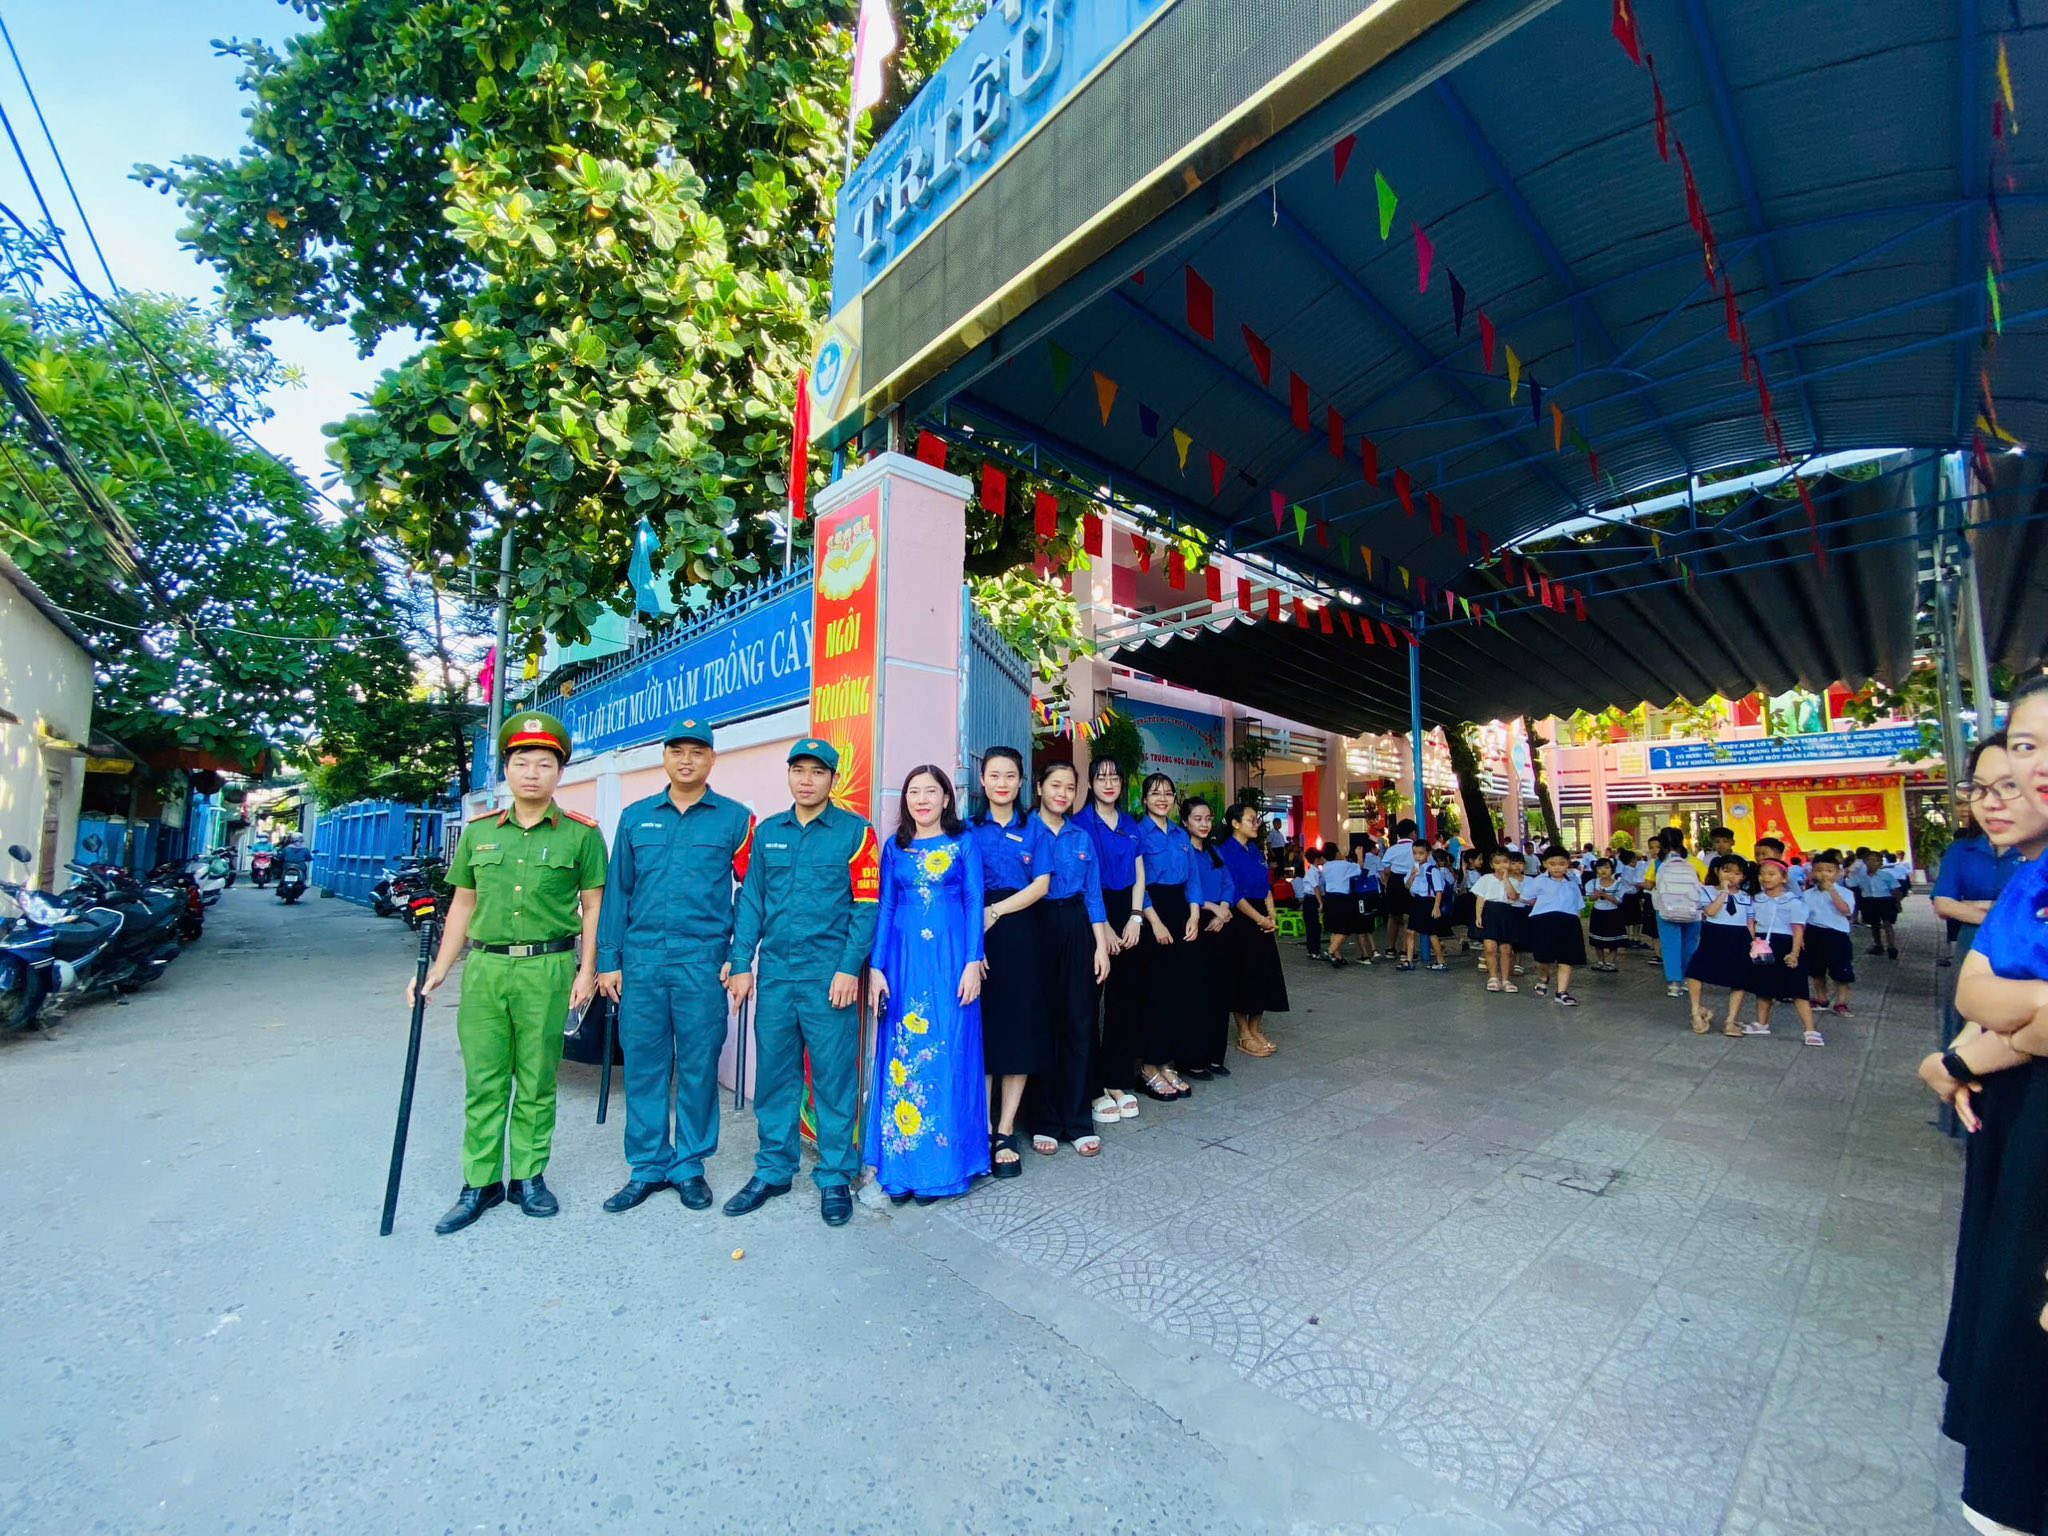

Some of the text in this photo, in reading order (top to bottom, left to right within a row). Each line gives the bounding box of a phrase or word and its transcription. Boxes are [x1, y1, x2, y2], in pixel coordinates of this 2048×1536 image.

[852, 0, 1064, 265] TRIỆU
[587, 702, 606, 745] LỢI
[606, 693, 628, 735] ÍCH
[628, 675, 663, 728] MƯỜI
[664, 662, 700, 716] NĂM
[703, 628, 765, 702] TRỒNG
[770, 611, 812, 678] CÂY
[825, 606, 861, 659] NGÔI
[815, 673, 870, 723] TRƯỜNG
